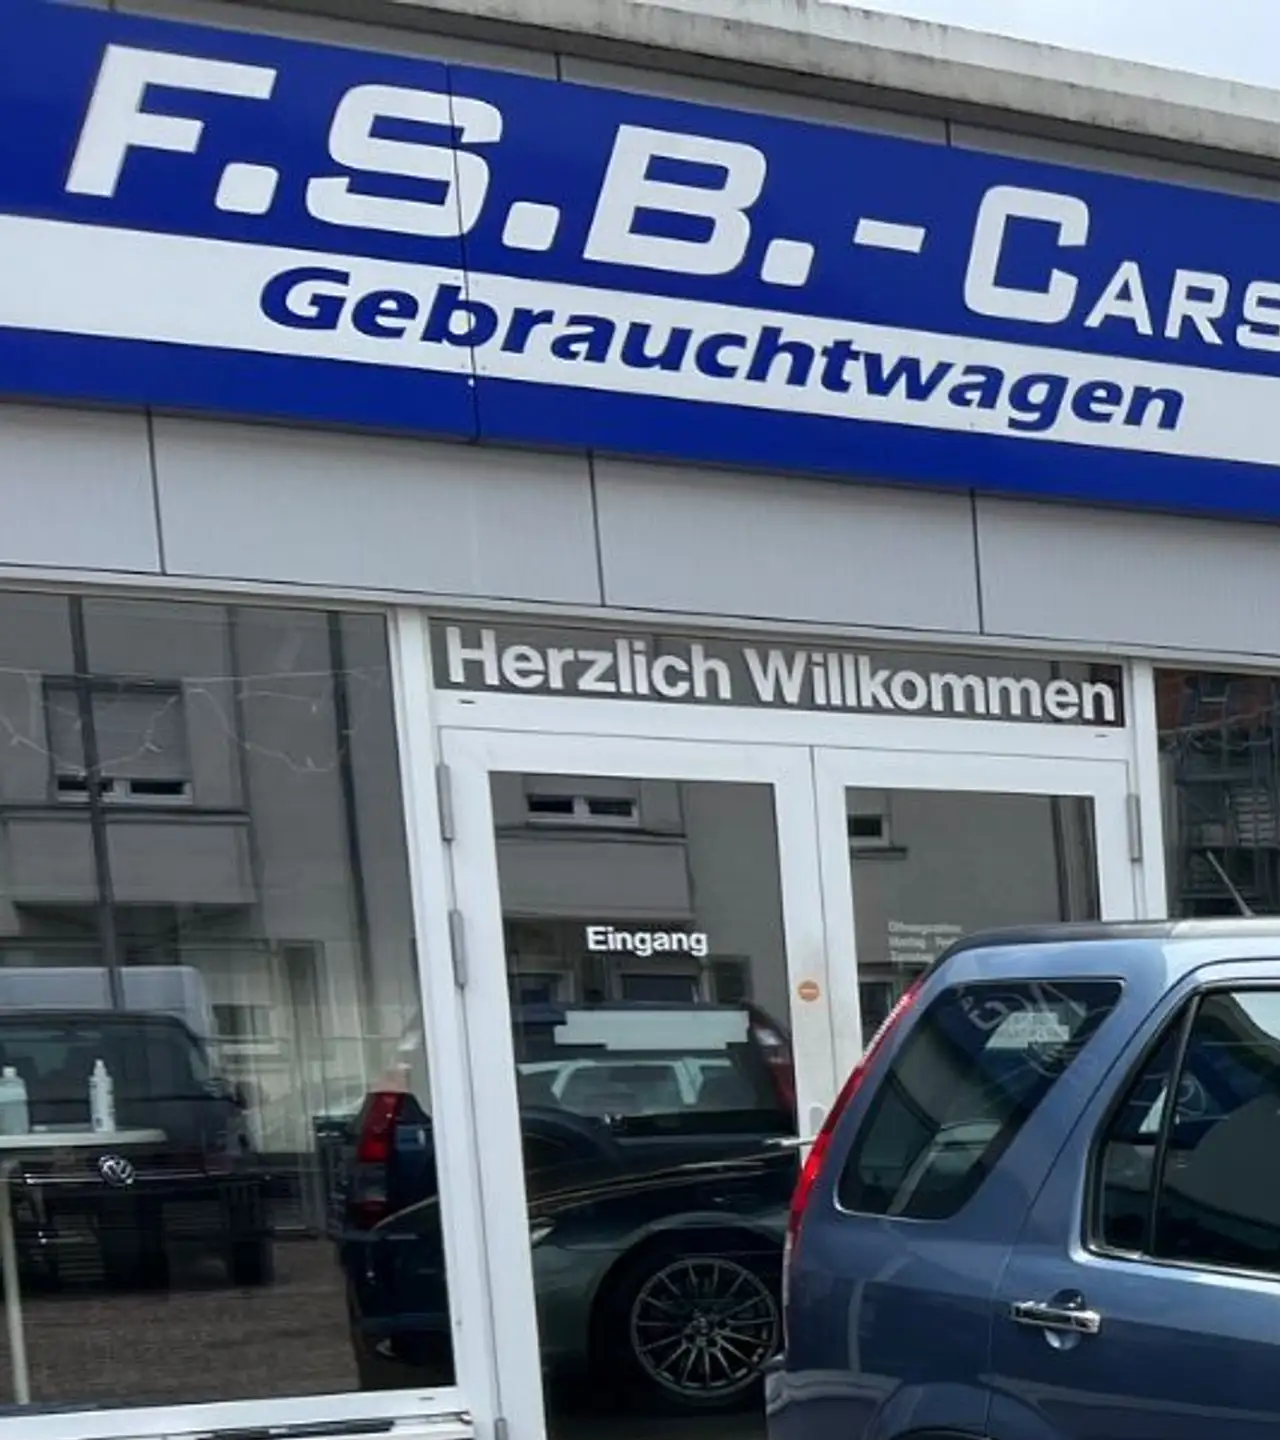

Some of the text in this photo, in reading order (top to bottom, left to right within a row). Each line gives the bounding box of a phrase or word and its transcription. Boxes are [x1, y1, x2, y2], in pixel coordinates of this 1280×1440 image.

[258, 265, 1185, 432] Gebrauchtwagen
[446, 625, 1115, 723] Herzlich Willkommen
[585, 925, 709, 957] Eingang
